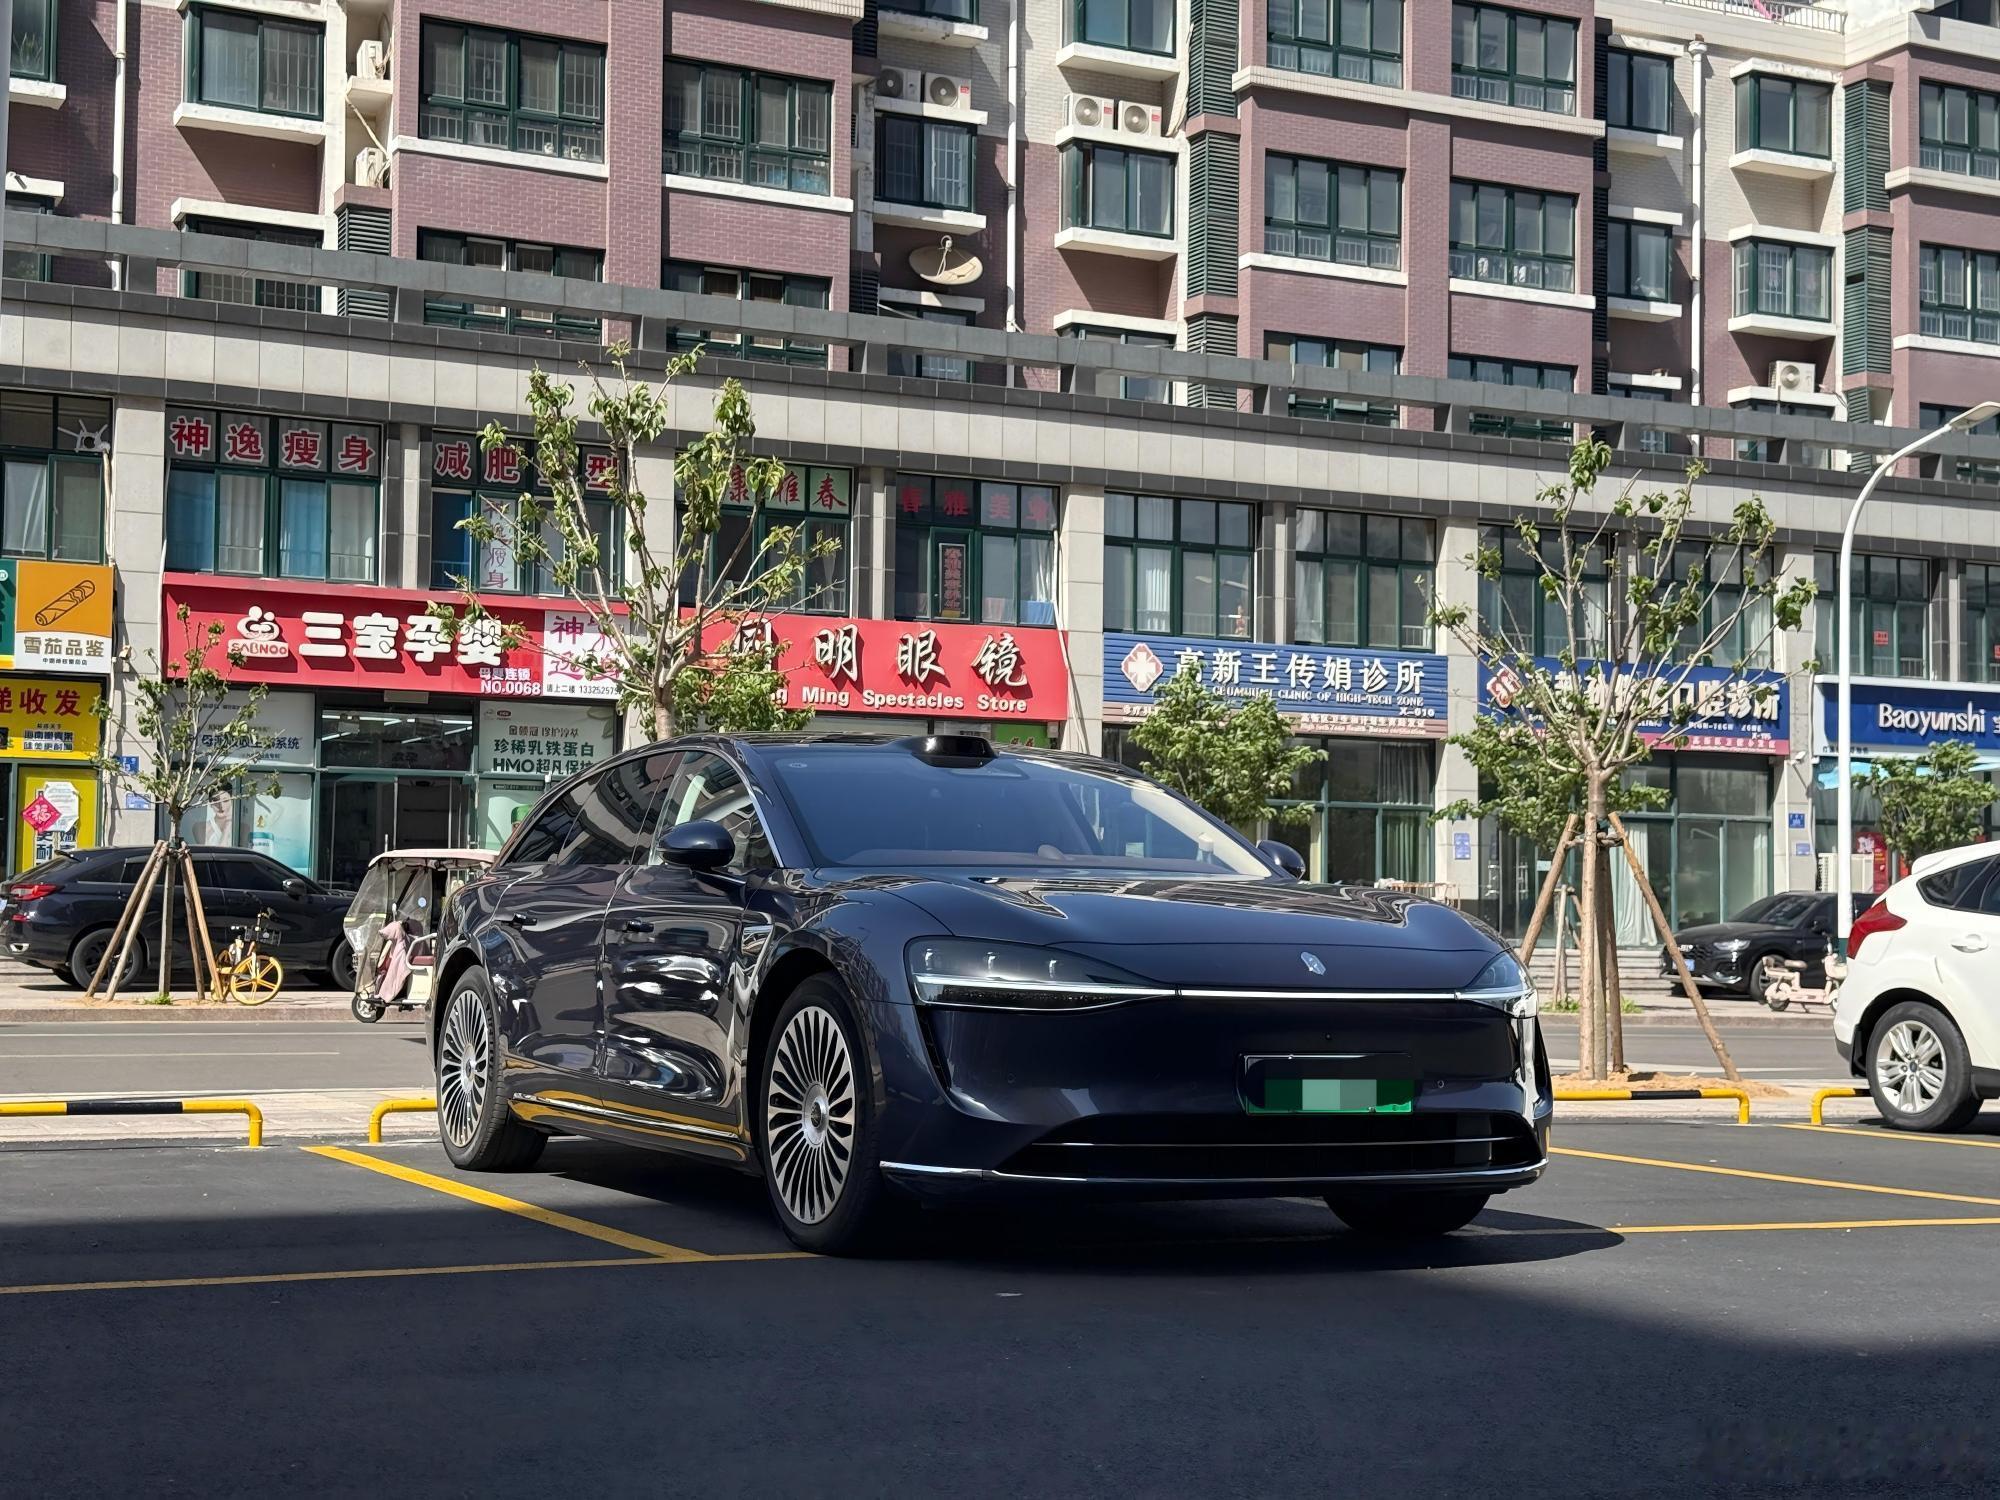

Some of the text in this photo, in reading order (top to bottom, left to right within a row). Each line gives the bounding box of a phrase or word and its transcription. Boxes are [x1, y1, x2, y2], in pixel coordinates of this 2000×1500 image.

[171, 416, 375, 473] 神逸瘦身
[435, 441, 619, 491] 减肥型
[24, 636, 104, 657] 雪茄品鉴
[299, 611, 501, 666] 三宝孕婴
[1174, 647, 1425, 695] 高新王传娟诊所
[480, 680, 541, 696] NO.0068
[802, 687, 849, 707] Ming
[863, 690, 964, 709] Spectacles
[977, 694, 1027, 712] Store
[1317, 691, 1331, 701] OF
[1336, 693, 1392, 704] HIGH-TECH
[1397, 696, 1424, 706] ZONE
[1879, 701, 1985, 736] Baoyunshi
[494, 739, 594, 757] 珍稀乳铁蛋白
